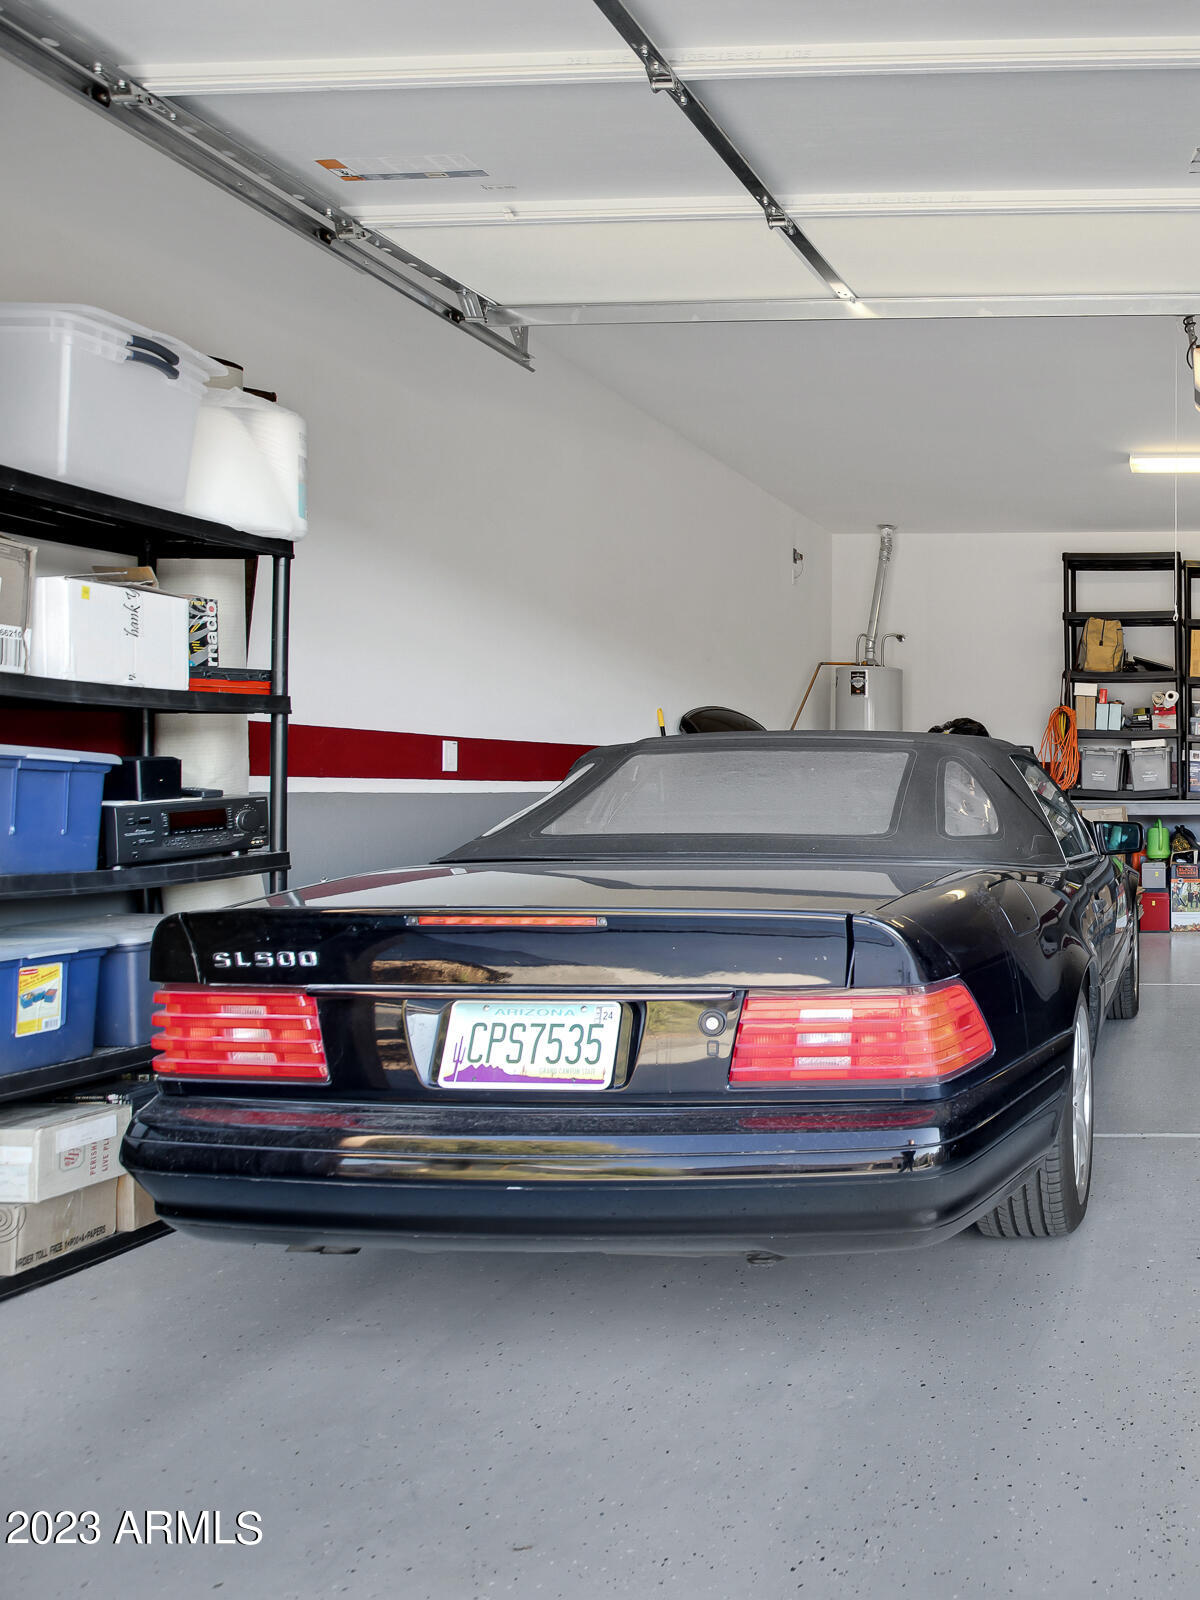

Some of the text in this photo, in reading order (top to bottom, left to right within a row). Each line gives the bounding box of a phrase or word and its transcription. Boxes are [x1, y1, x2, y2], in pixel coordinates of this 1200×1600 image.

[123, 604, 141, 638] hank
[213, 951, 320, 968] SL500
[494, 1008, 576, 1017] ARIZONA
[603, 1011, 613, 1021] 24
[467, 1022, 604, 1065] CPS7535
